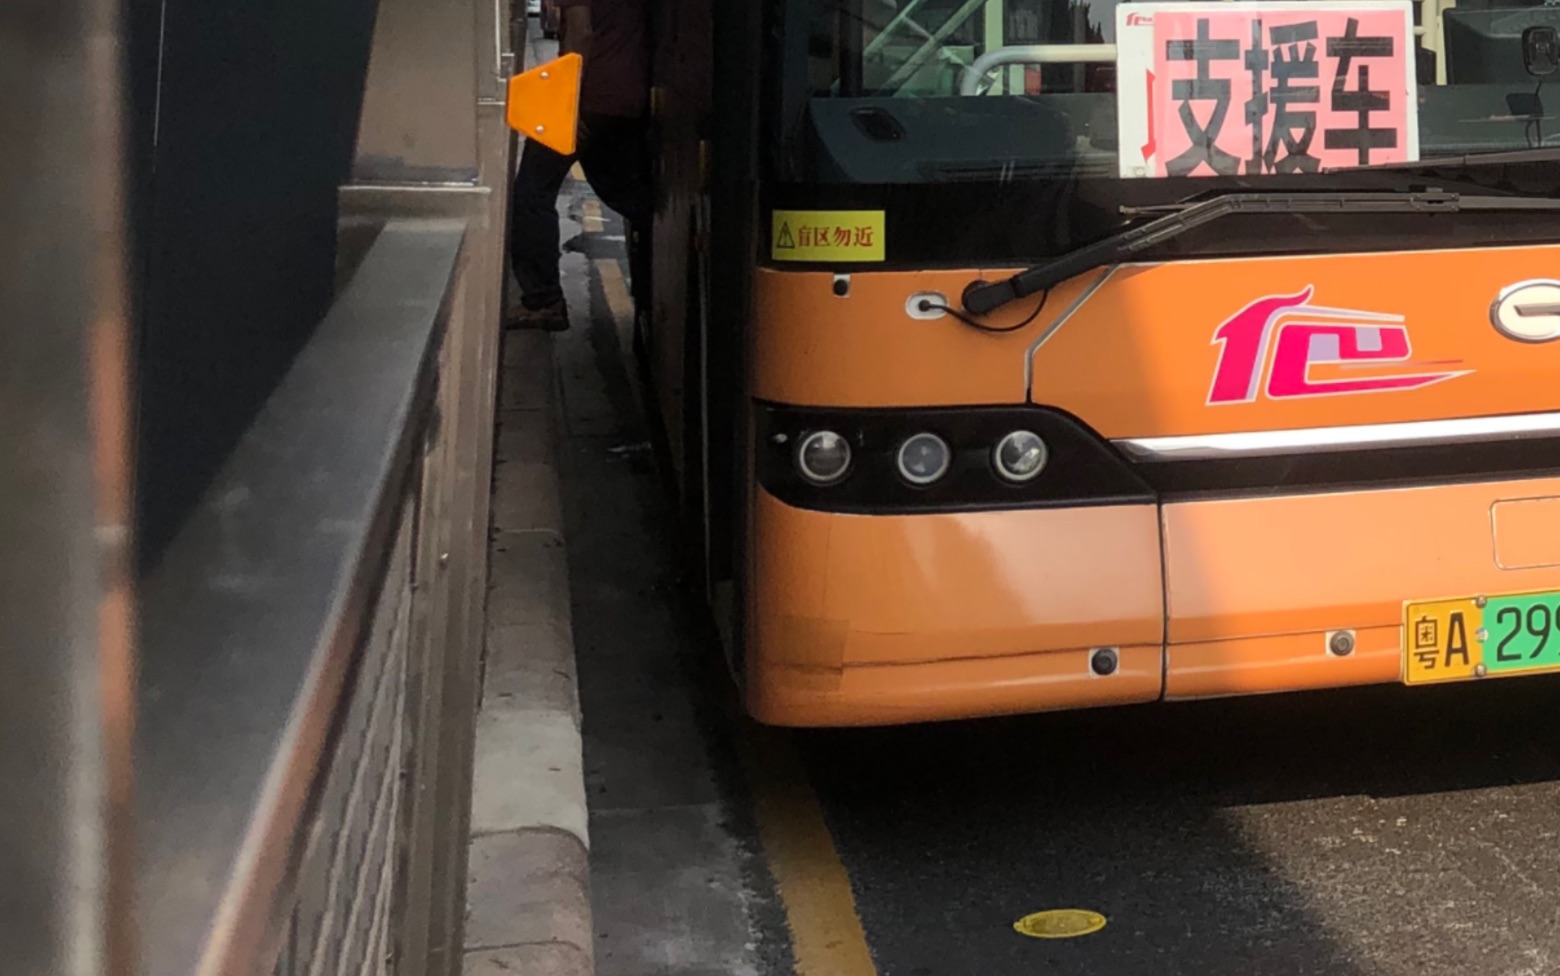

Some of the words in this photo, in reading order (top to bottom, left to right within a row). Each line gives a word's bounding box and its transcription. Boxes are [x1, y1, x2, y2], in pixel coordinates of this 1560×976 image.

[1164, 17, 1398, 176] 支援车
[797, 225, 875, 248] 盲区勿近
[1413, 612, 1470, 671] 粤A
